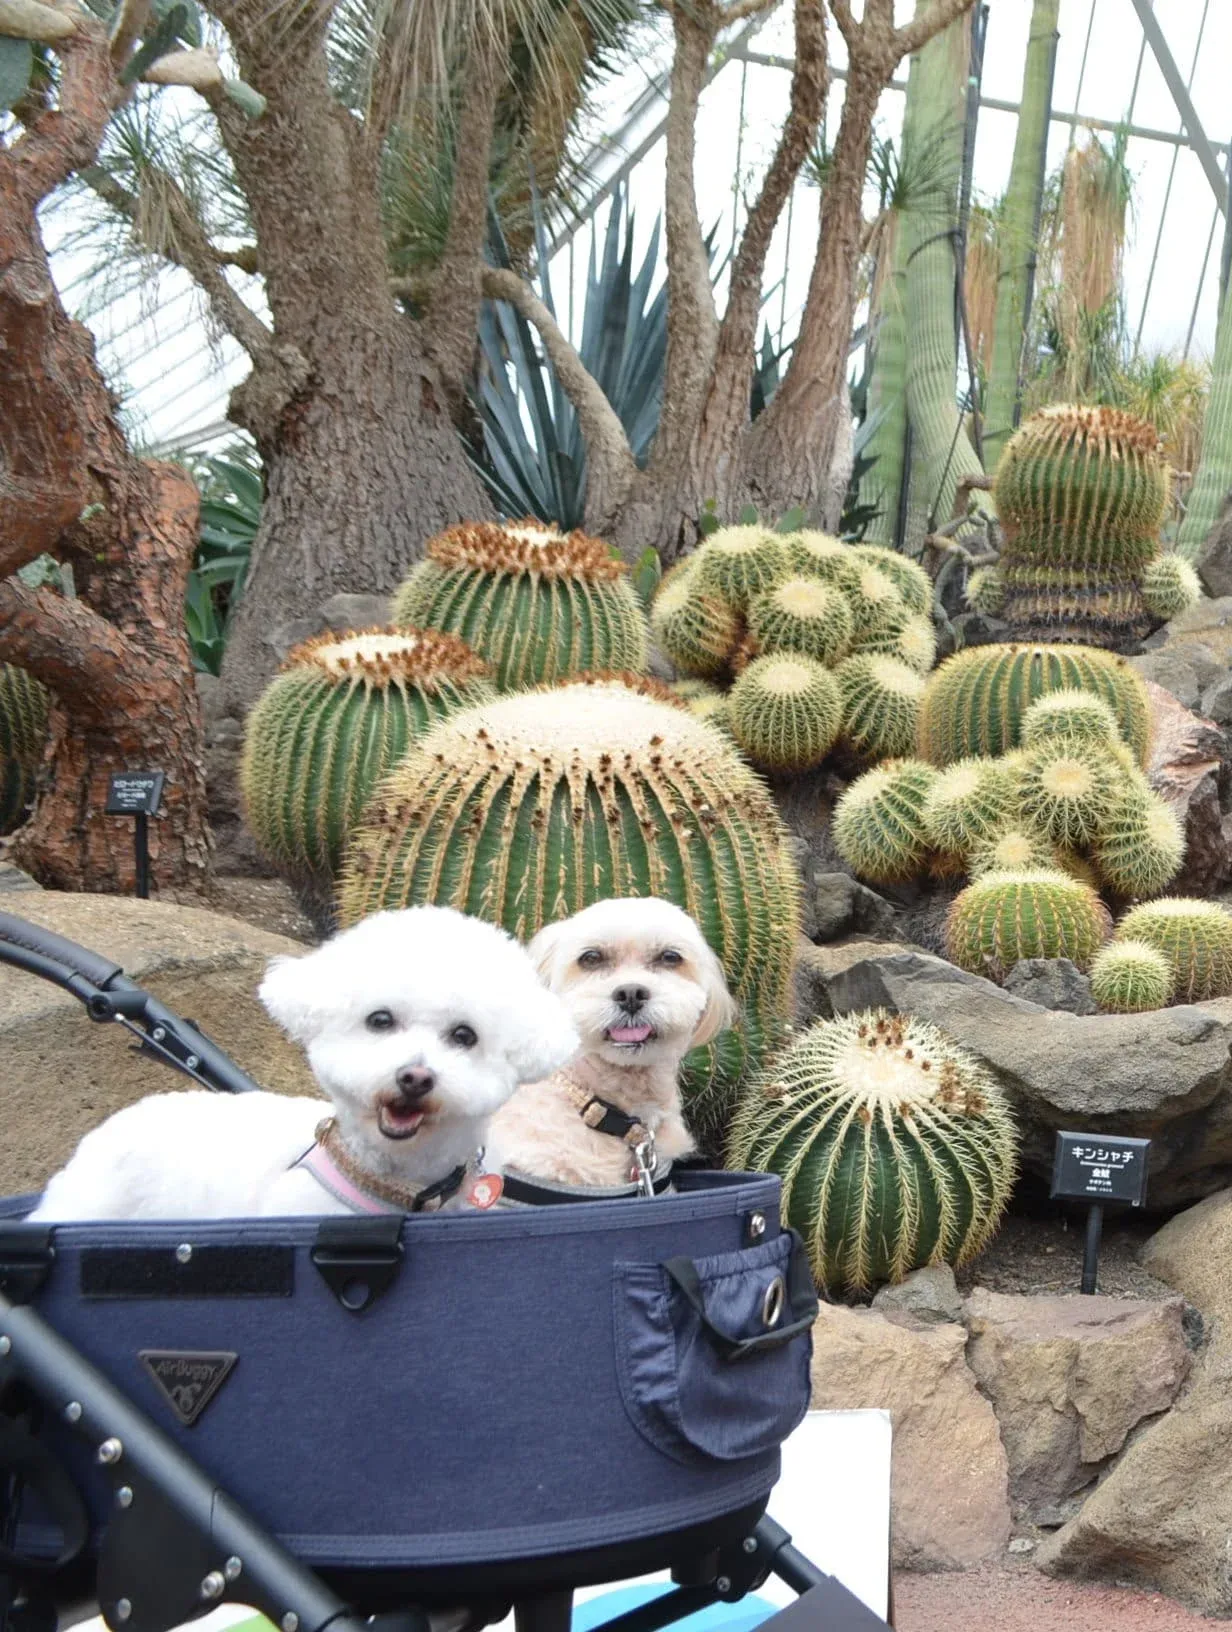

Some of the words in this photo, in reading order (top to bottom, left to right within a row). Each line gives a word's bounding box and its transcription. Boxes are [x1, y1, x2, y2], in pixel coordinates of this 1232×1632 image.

[1072, 1146, 1134, 1163] キンシャチ
